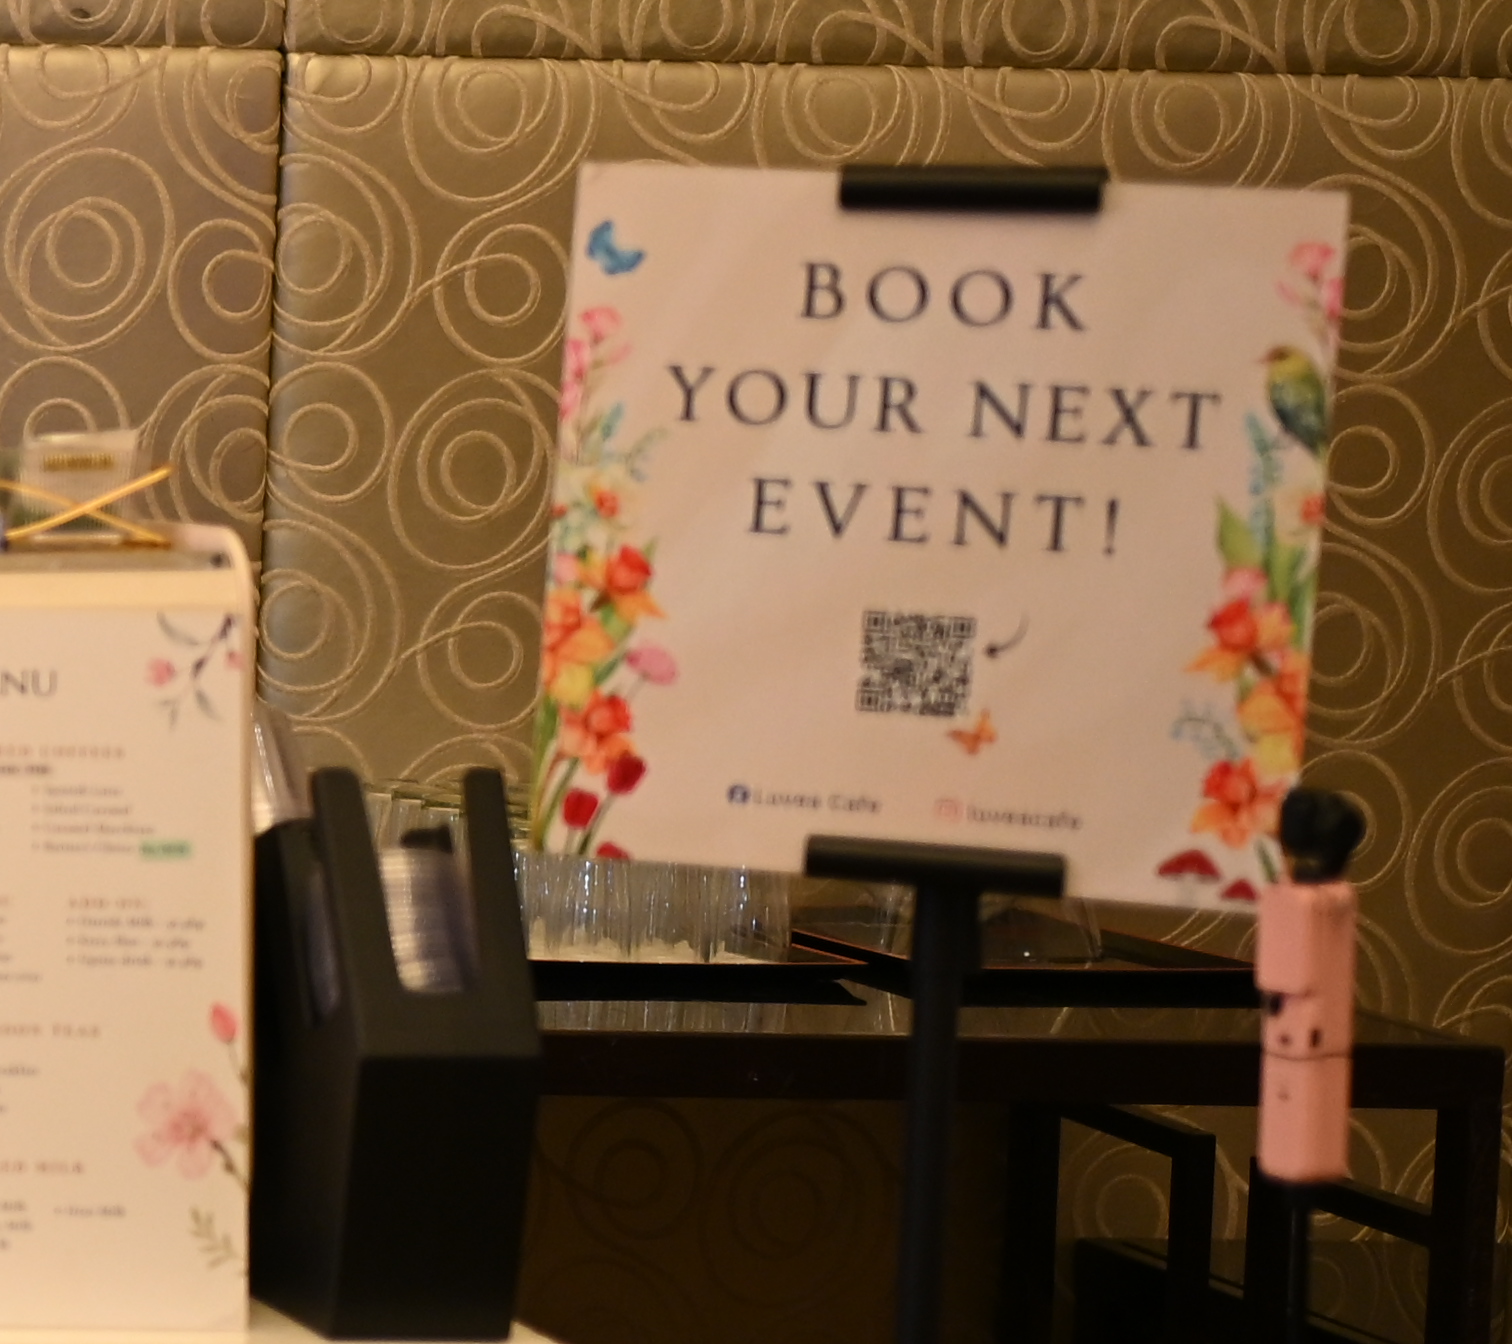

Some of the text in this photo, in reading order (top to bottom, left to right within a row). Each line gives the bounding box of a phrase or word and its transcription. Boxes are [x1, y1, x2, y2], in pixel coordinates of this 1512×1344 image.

[800, 261, 1090, 333] BOOK
[667, 364, 1222, 451] YOUR NEXT
[747, 477, 1120, 557] EVENT!
